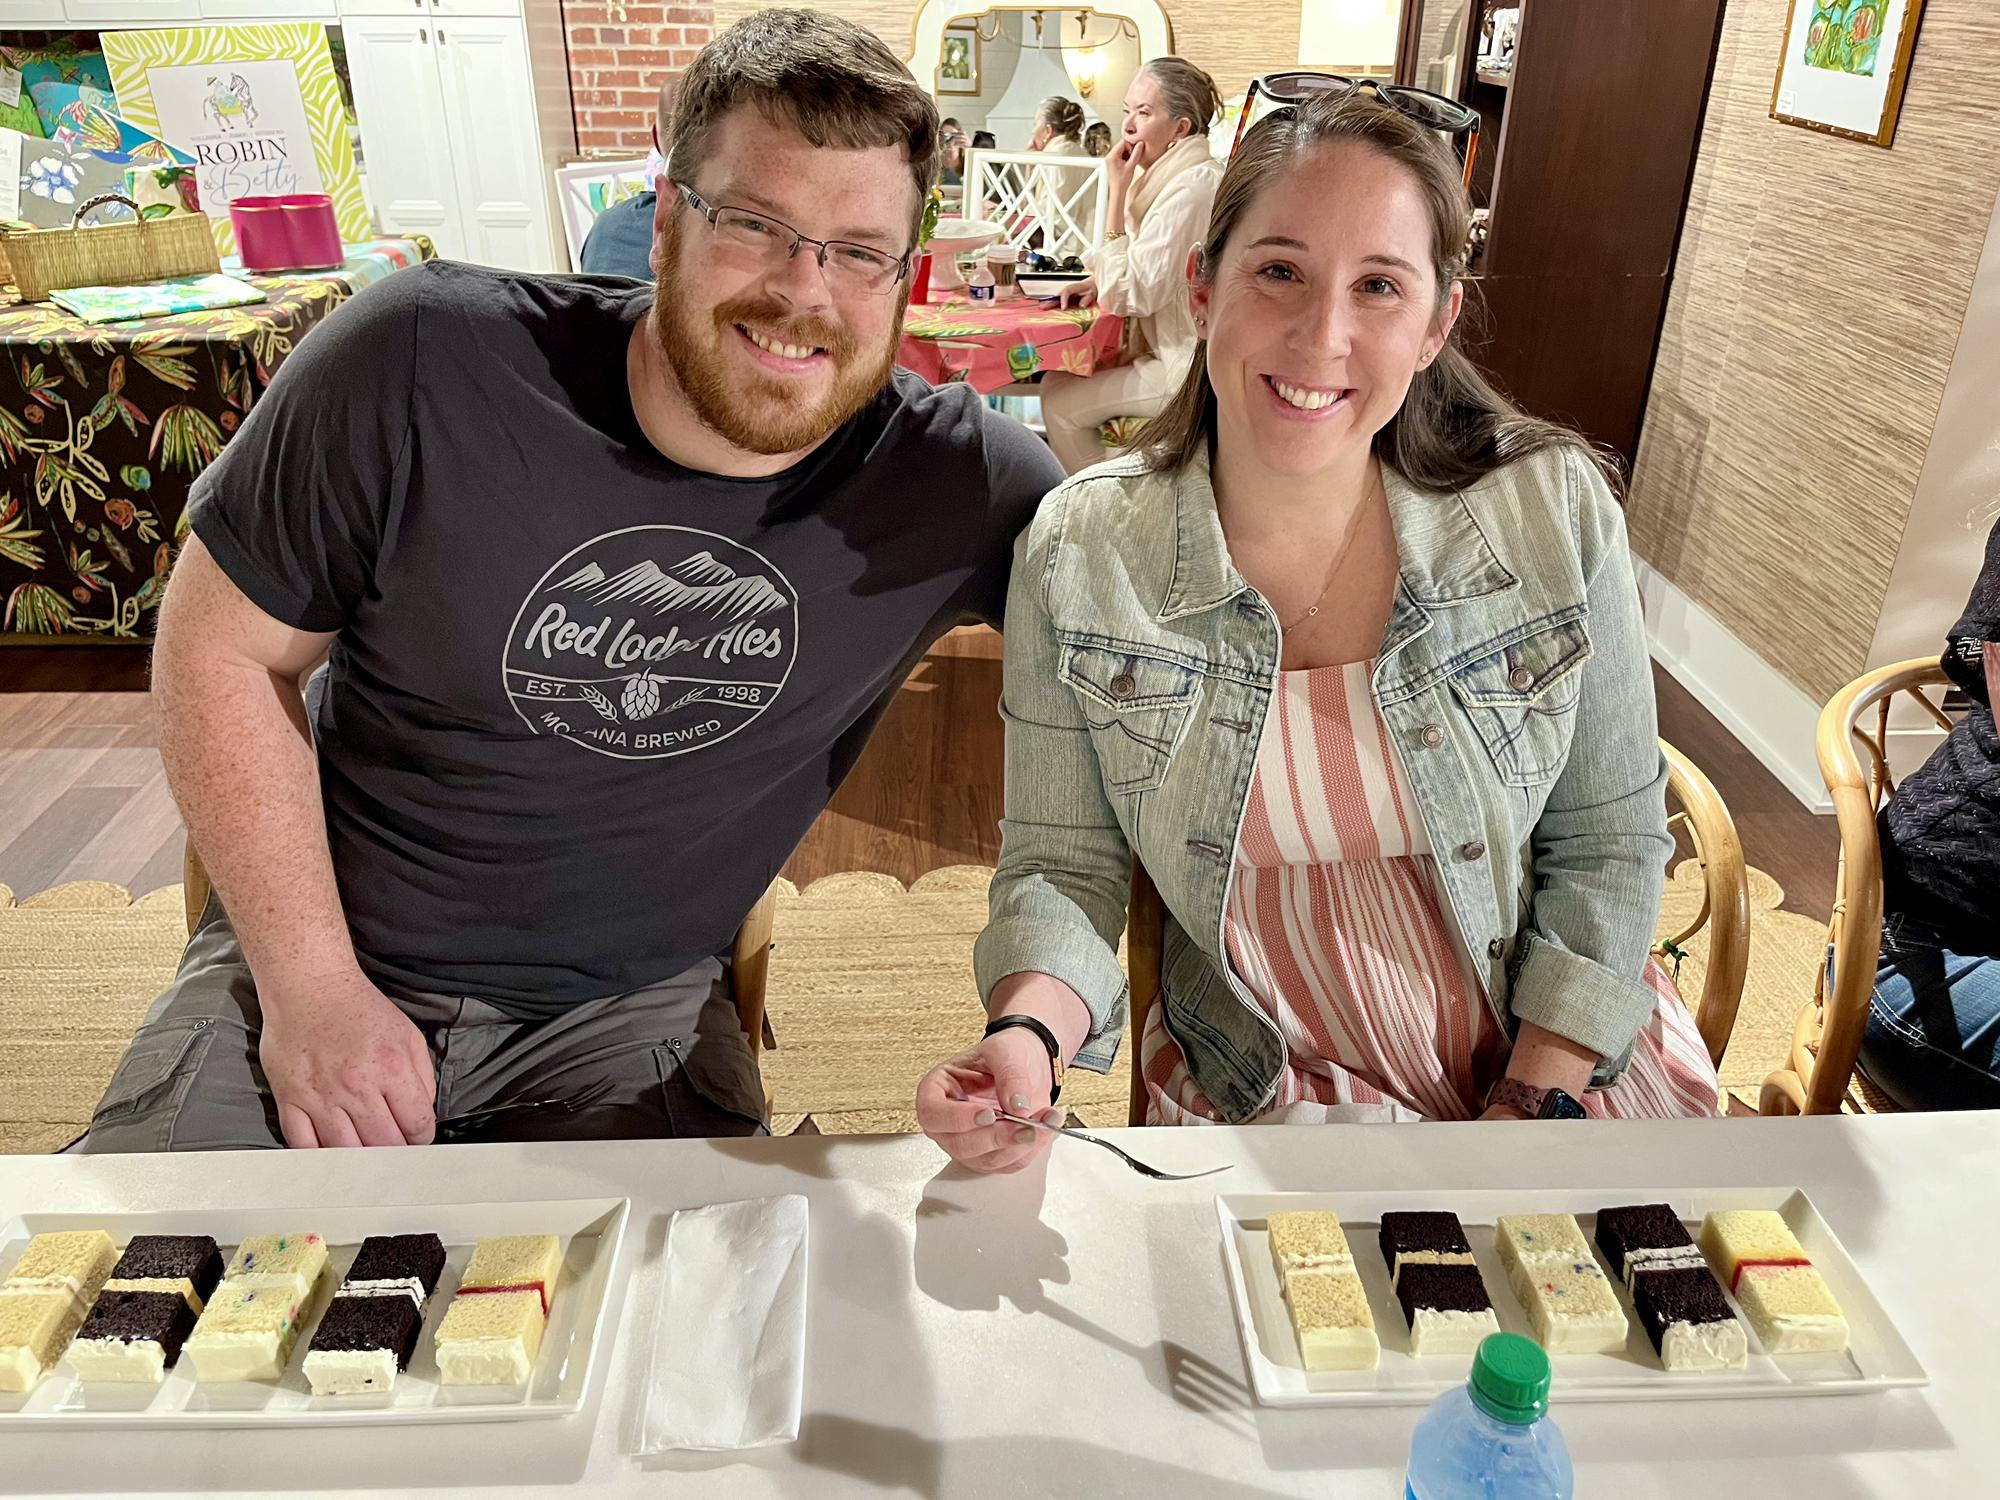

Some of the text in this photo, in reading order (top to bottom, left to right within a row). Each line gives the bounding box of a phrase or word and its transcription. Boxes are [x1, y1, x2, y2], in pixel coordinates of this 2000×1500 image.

[194, 137, 287, 166] ROBIN
[203, 156, 302, 206] & Betty
[524, 602, 782, 669] Red Lod Ales
[525, 679, 567, 697] EST.
[717, 685, 761, 702] 1998
[540, 711, 722, 749] MOANA BREWED
